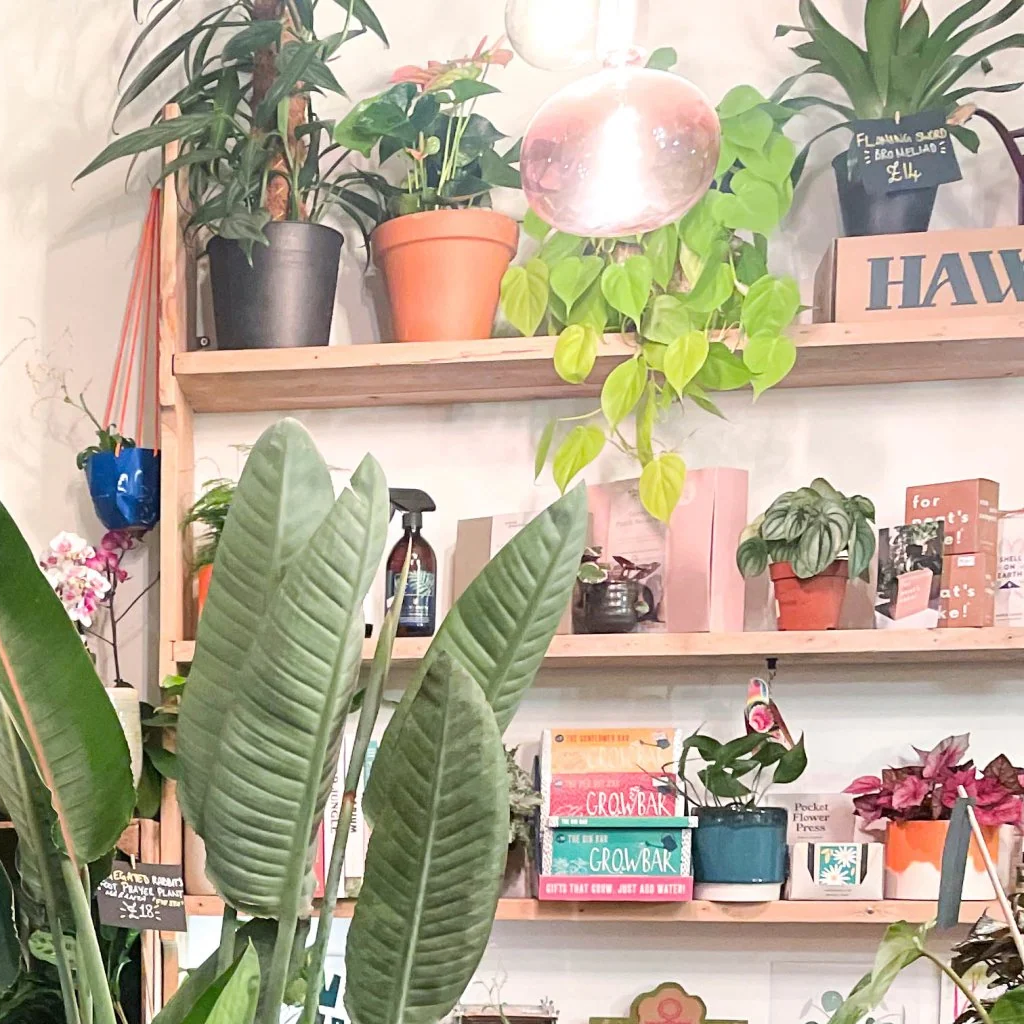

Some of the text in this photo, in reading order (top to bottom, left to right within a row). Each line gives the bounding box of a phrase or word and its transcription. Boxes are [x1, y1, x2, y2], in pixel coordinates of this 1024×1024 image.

[886, 160, 922, 184] £14
[912, 494, 940, 509] for
[997, 571, 1023, 579] EARTH
[794, 803, 829, 812] Pocket
[792, 813, 830, 822] Flower
[796, 823, 826, 832] Press
[156, 887, 184, 899] PLANT
[545, 883, 568, 894] GIFTS
[569, 883, 589, 894] THAT
[617, 883, 637, 895] JUST
[639, 884, 655, 895] ADD
[657, 884, 686, 895] WATER!
